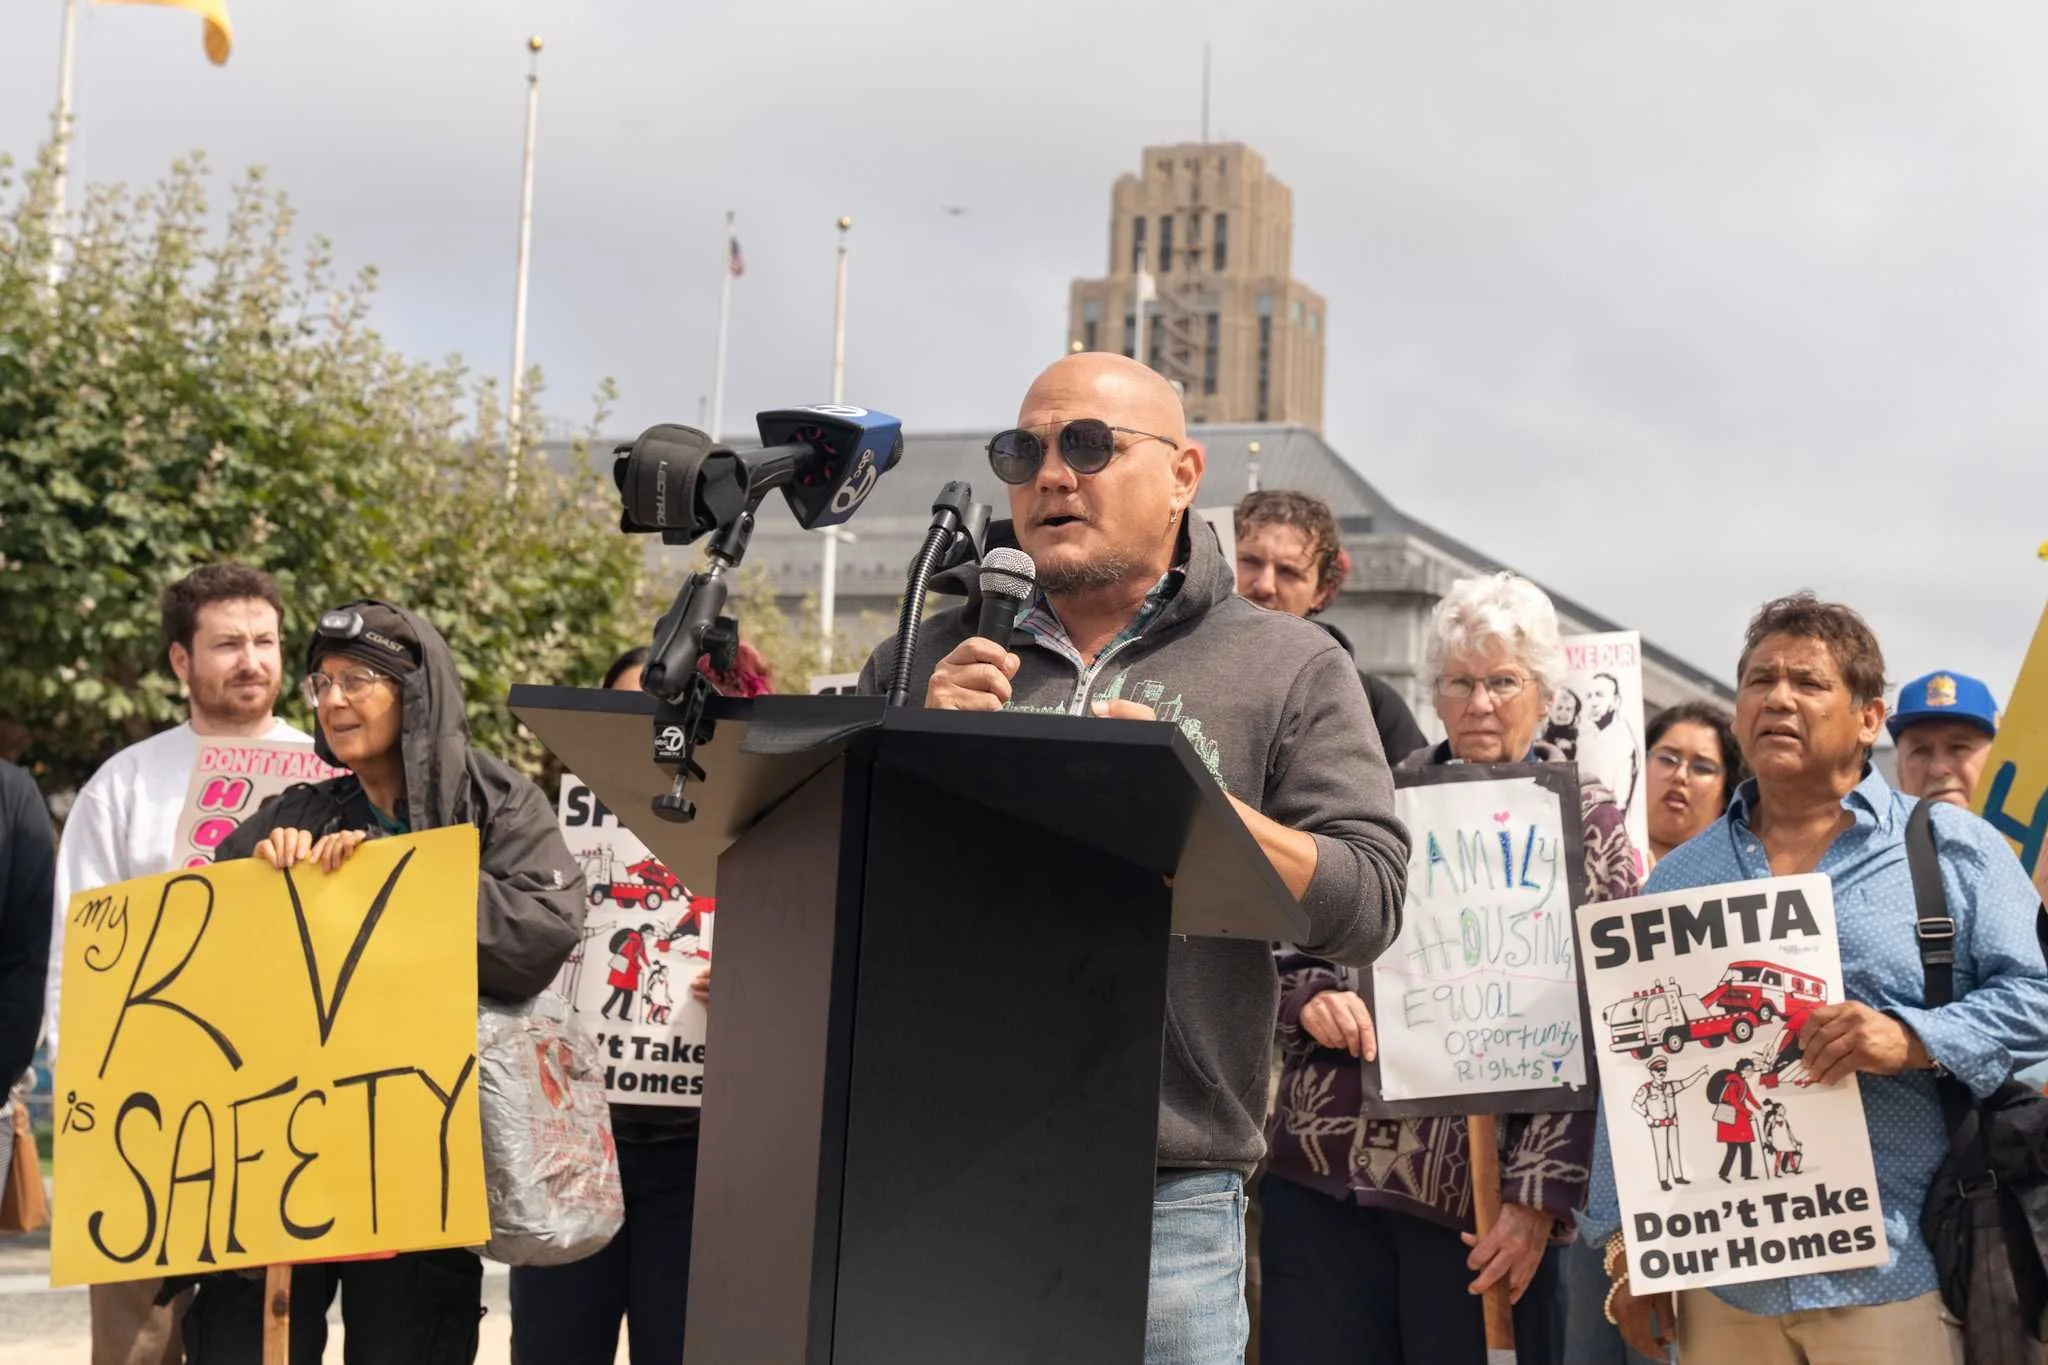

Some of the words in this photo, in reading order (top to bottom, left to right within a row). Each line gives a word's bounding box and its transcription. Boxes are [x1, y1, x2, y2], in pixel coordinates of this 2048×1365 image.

[73, 895, 129, 972] my
[1590, 889, 1821, 970] SFMTA
[631, 1036, 706, 1064] Take
[61, 1090, 97, 1135] is
[88, 1053, 477, 1266] SAFETY
[1633, 1202, 1759, 1242] Don't
[1763, 1183, 1869, 1223] Take
[1640, 1246, 1728, 1279] Our
[1727, 1225, 1876, 1267] Homes
